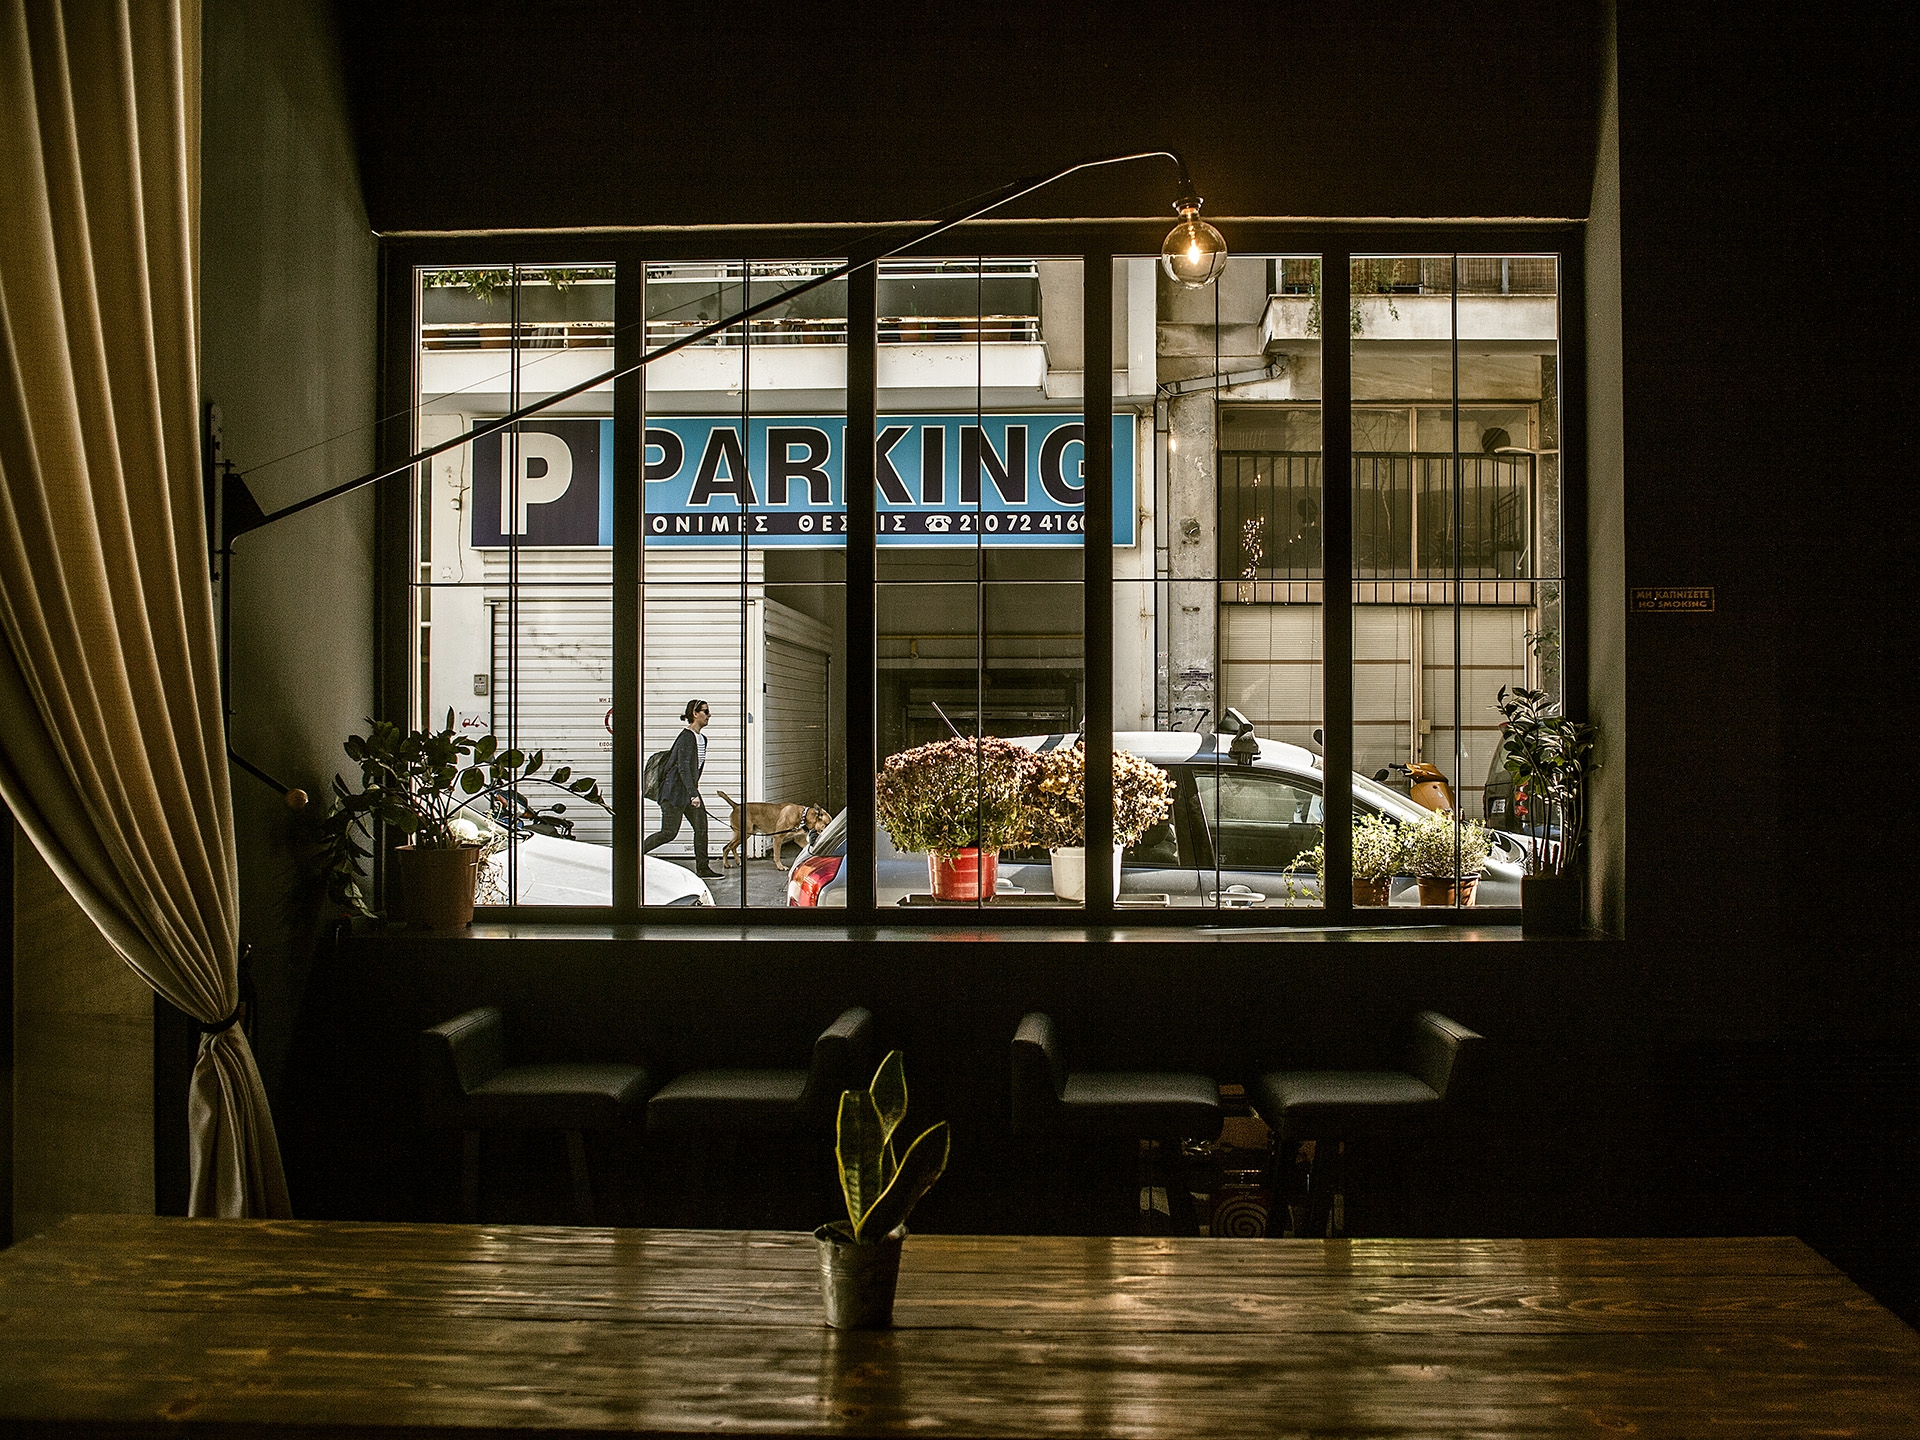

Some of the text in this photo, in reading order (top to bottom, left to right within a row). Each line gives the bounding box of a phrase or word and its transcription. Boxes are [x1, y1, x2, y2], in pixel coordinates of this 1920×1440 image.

[500, 432, 573, 536] P
[645, 422, 1085, 507] PARKING
[652, 515, 768, 533] ΟΝΙΜΕΣ
[798, 514, 906, 532] ΘΕΣΙΣ
[959, 514, 999, 532] 210
[1006, 514, 1032, 532] 72
[1639, 600, 1708, 608] NO SMOKING
